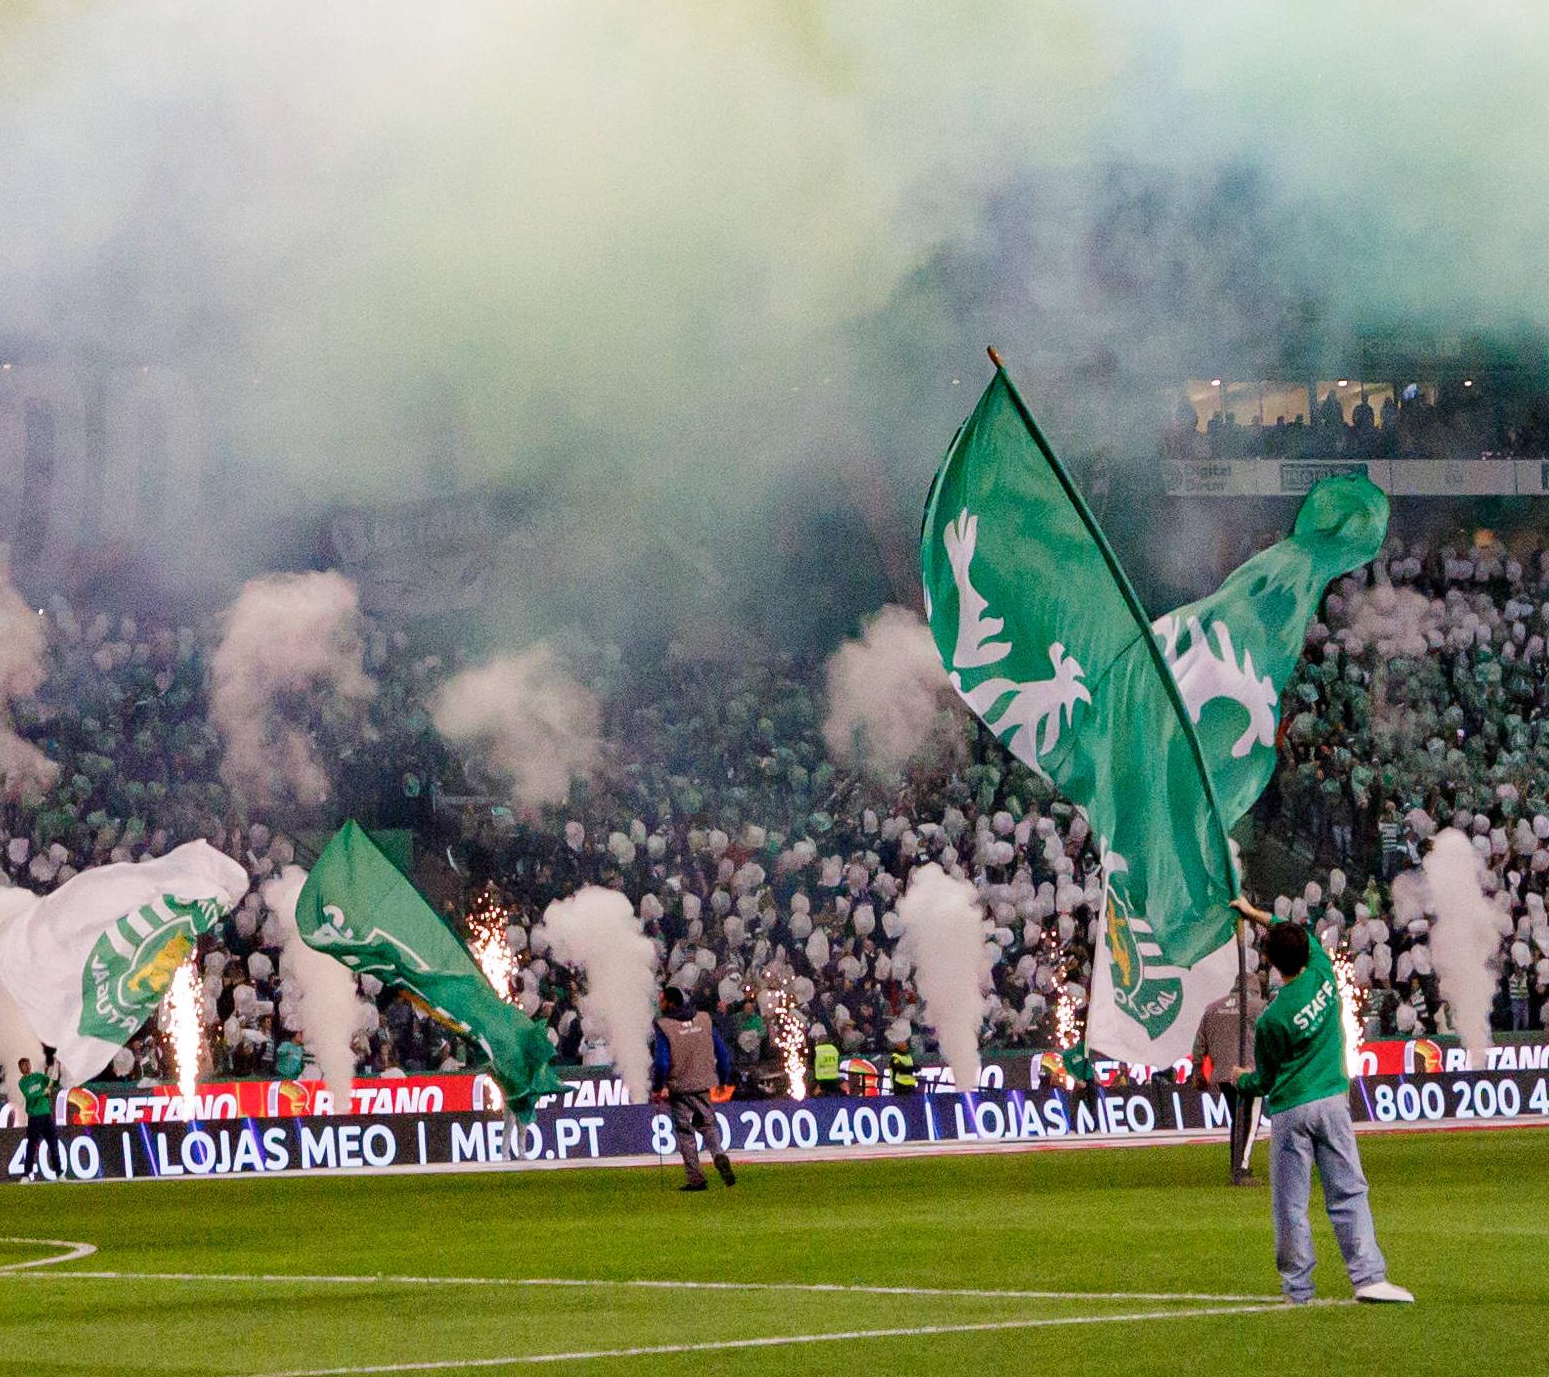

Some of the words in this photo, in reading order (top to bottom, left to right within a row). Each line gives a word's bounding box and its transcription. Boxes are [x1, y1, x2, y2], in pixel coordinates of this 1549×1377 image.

[1291, 978, 1337, 1032] STAFF
[953, 1097, 1067, 1141] LOJAS
[1373, 1081, 1446, 1122] 800
[1451, 1078, 1521, 1119] 200
[156, 1127, 289, 1176] LOJAS
[300, 1123, 397, 1170] MEO
[743, 1109, 819, 1152] 200
[828, 1105, 907, 1147] 400
